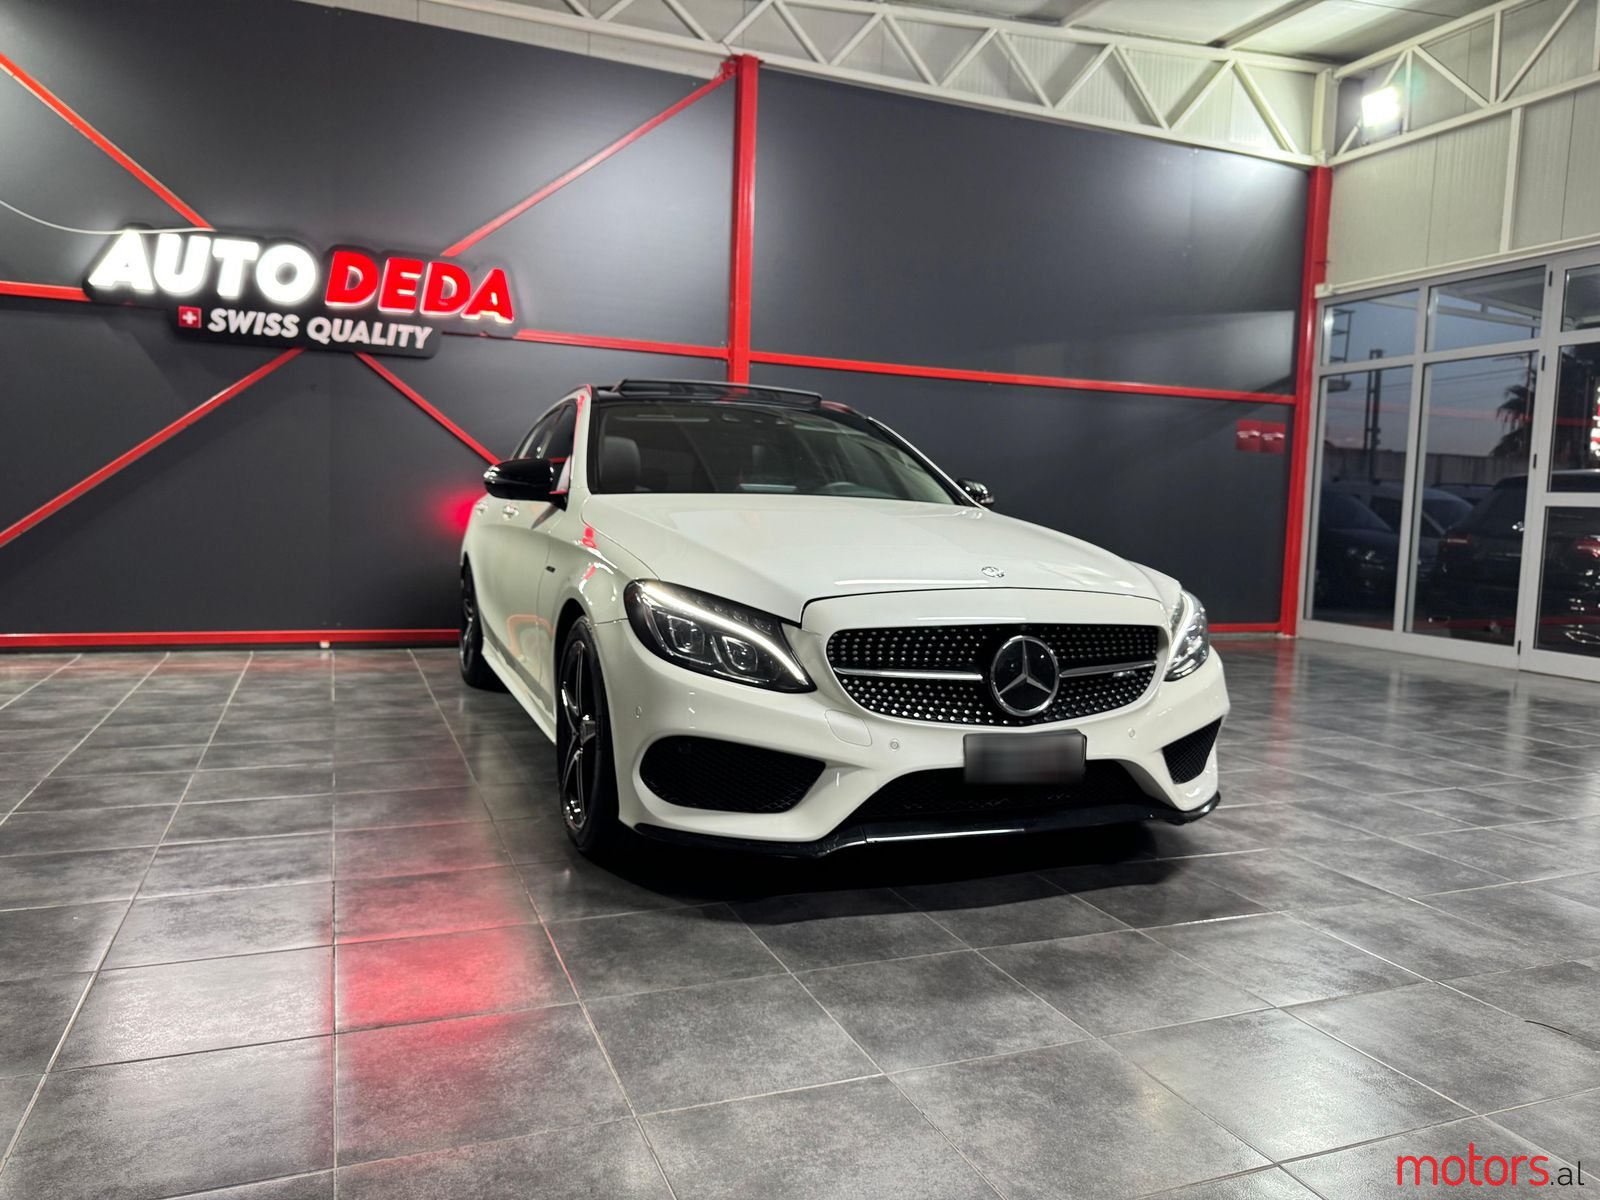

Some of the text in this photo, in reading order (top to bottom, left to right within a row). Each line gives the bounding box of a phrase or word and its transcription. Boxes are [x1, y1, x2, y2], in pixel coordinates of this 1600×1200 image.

[88, 229, 514, 324] AUTO DEDA
[207, 308, 433, 350] SWISS QUALITY
